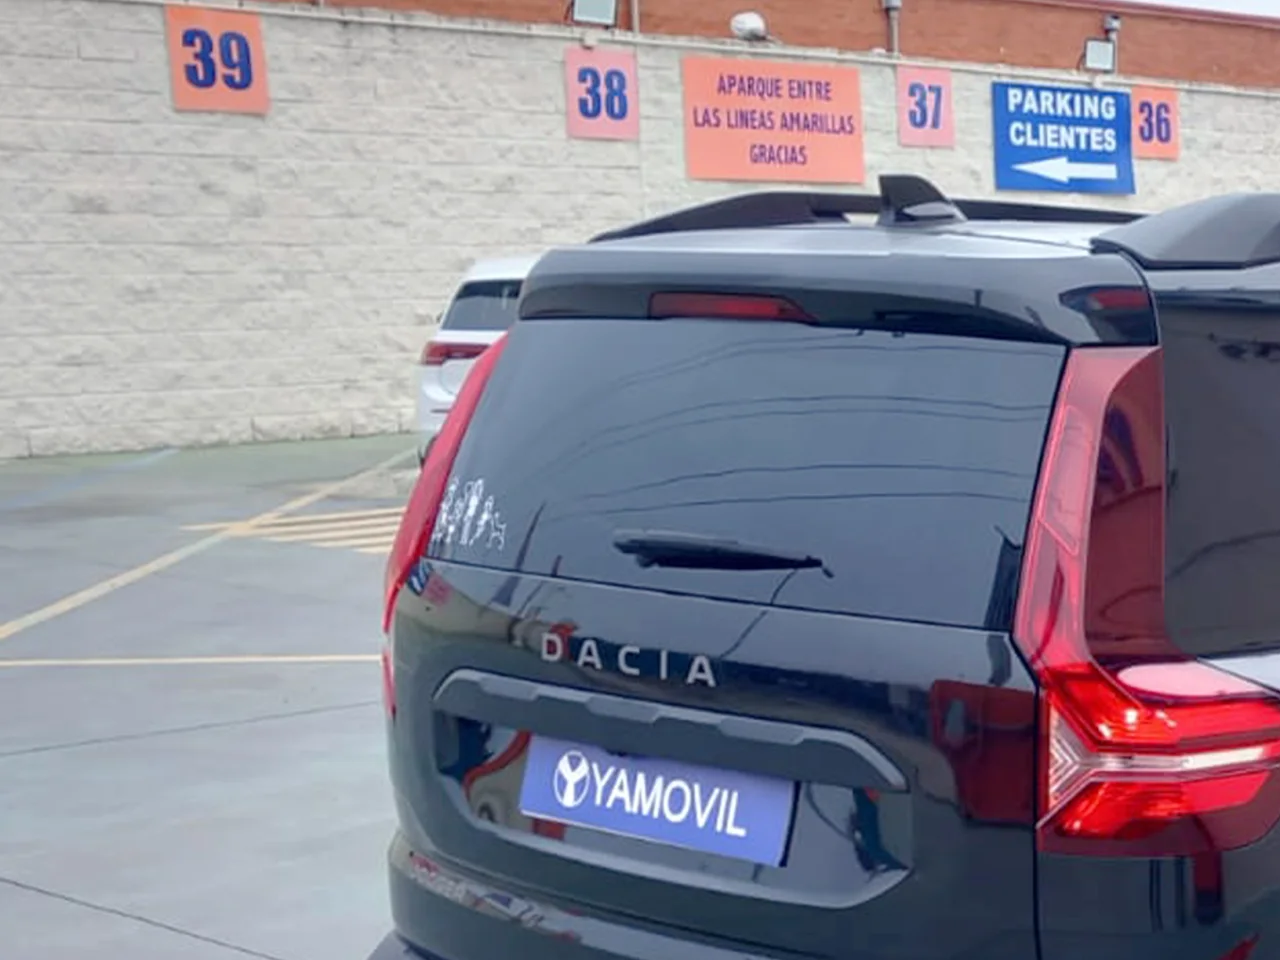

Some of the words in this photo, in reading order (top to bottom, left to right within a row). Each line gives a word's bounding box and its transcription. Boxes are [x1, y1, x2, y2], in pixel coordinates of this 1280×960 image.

[181, 27, 254, 92] 39
[576, 66, 629, 122] 38
[716, 73, 784, 99] APARQUE
[787, 79, 833, 101] ENTRE
[907, 82, 943, 130] 37
[1007, 87, 1117, 120] PARKING
[692, 106, 721, 128] LAS
[726, 108, 775, 131] LINEAS
[779, 110, 855, 135] AMARILLAS
[1009, 120, 1117, 152] CLIENTES
[1138, 100, 1172, 144] 36
[749, 144, 808, 166] GRACIAS
[540, 631, 718, 688] DACIA
[590, 761, 747, 838] YAMOVIL
